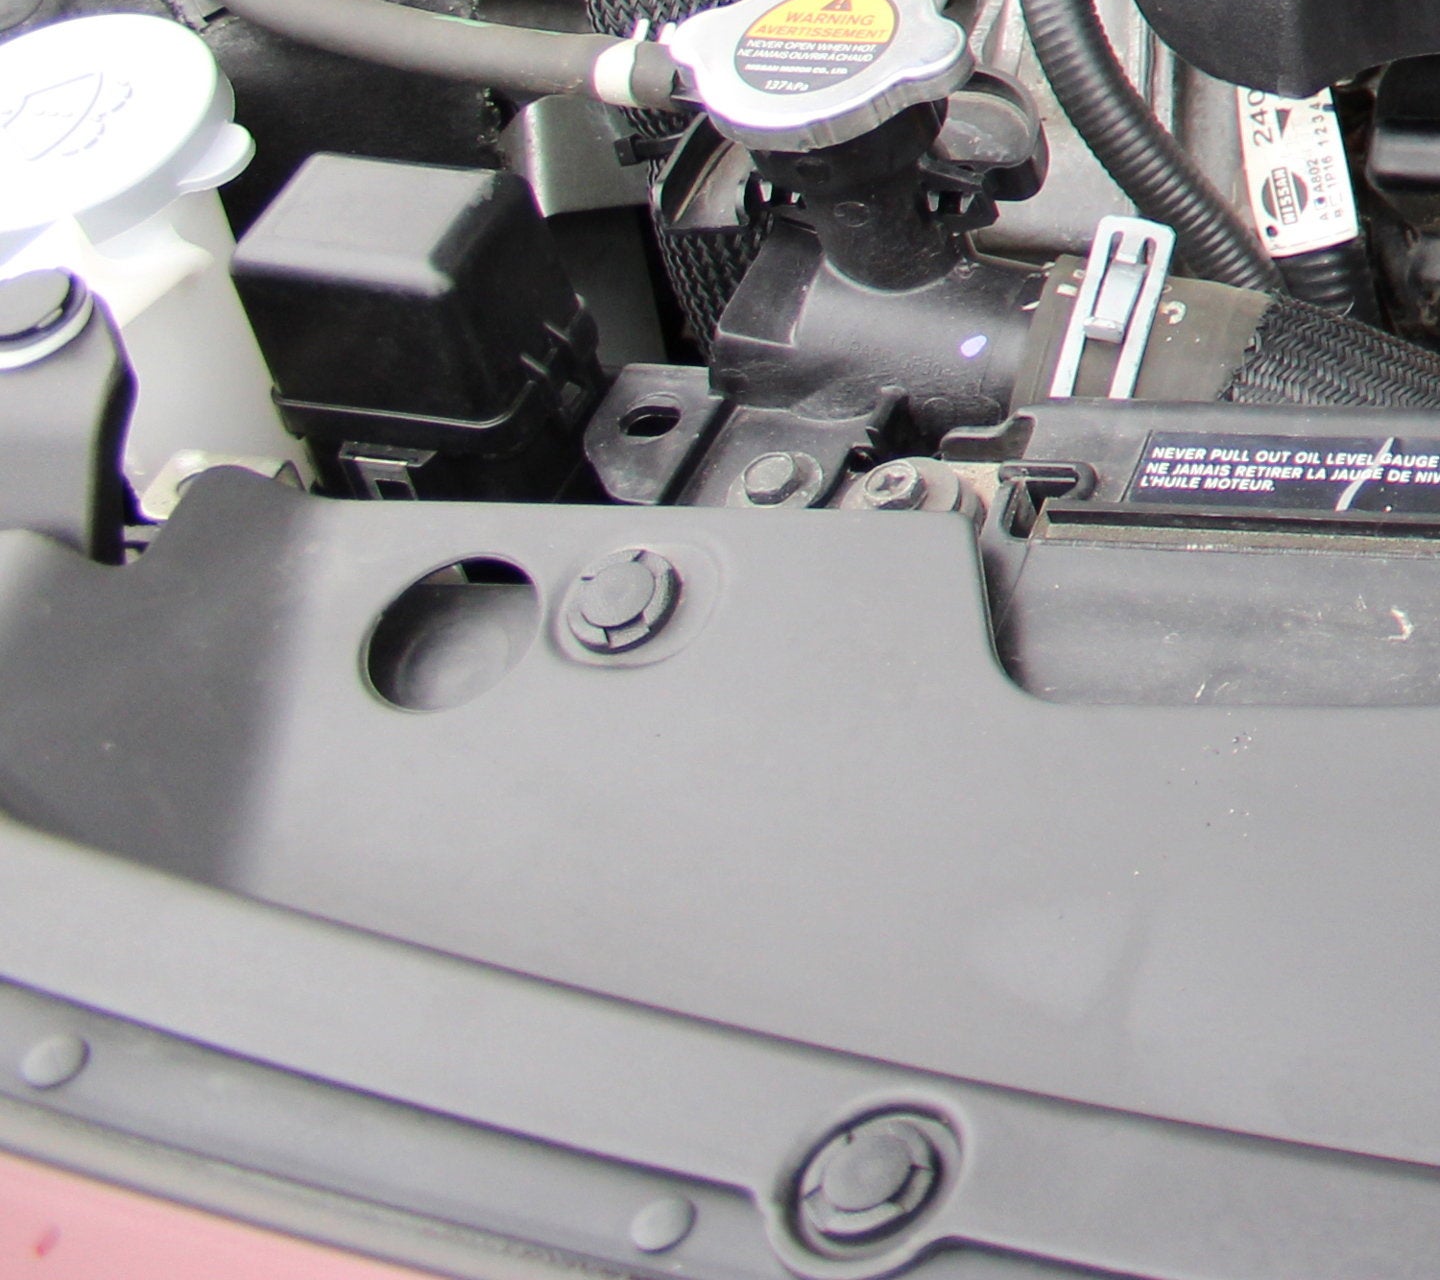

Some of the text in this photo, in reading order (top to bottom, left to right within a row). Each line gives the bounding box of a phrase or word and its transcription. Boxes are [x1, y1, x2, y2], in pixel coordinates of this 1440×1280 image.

[785, 11, 877, 26] WARNING
[755, 24, 888, 39] AVERTISSEMENT
[746, 39, 784, 49] NEVER
[785, 41, 816, 50] OPEN
[818, 43, 850, 52] WHEN
[737, 48, 752, 57] NE
[752, 49, 788, 59] JAMAIS
[836, 54, 873, 62] CHAUD
[1272, 168, 1297, 224] NISSAN
[1151, 447, 1207, 461] NEVER
[1210, 449, 1250, 462] PULL
[1255, 450, 1291, 463] OUT
[1294, 451, 1321, 464] OIL
[1325, 453, 1375, 466] LEVEL
[1145, 463, 1170, 475] NE
[1172, 463, 1230, 477] JAMAIS
[1234, 466, 1303, 479] RETIRER
[1306, 468, 1326, 480] LA
[1387, 470, 1413, 483] DE
[1139, 476, 1275, 491] L'HUILE MOTEUR.
